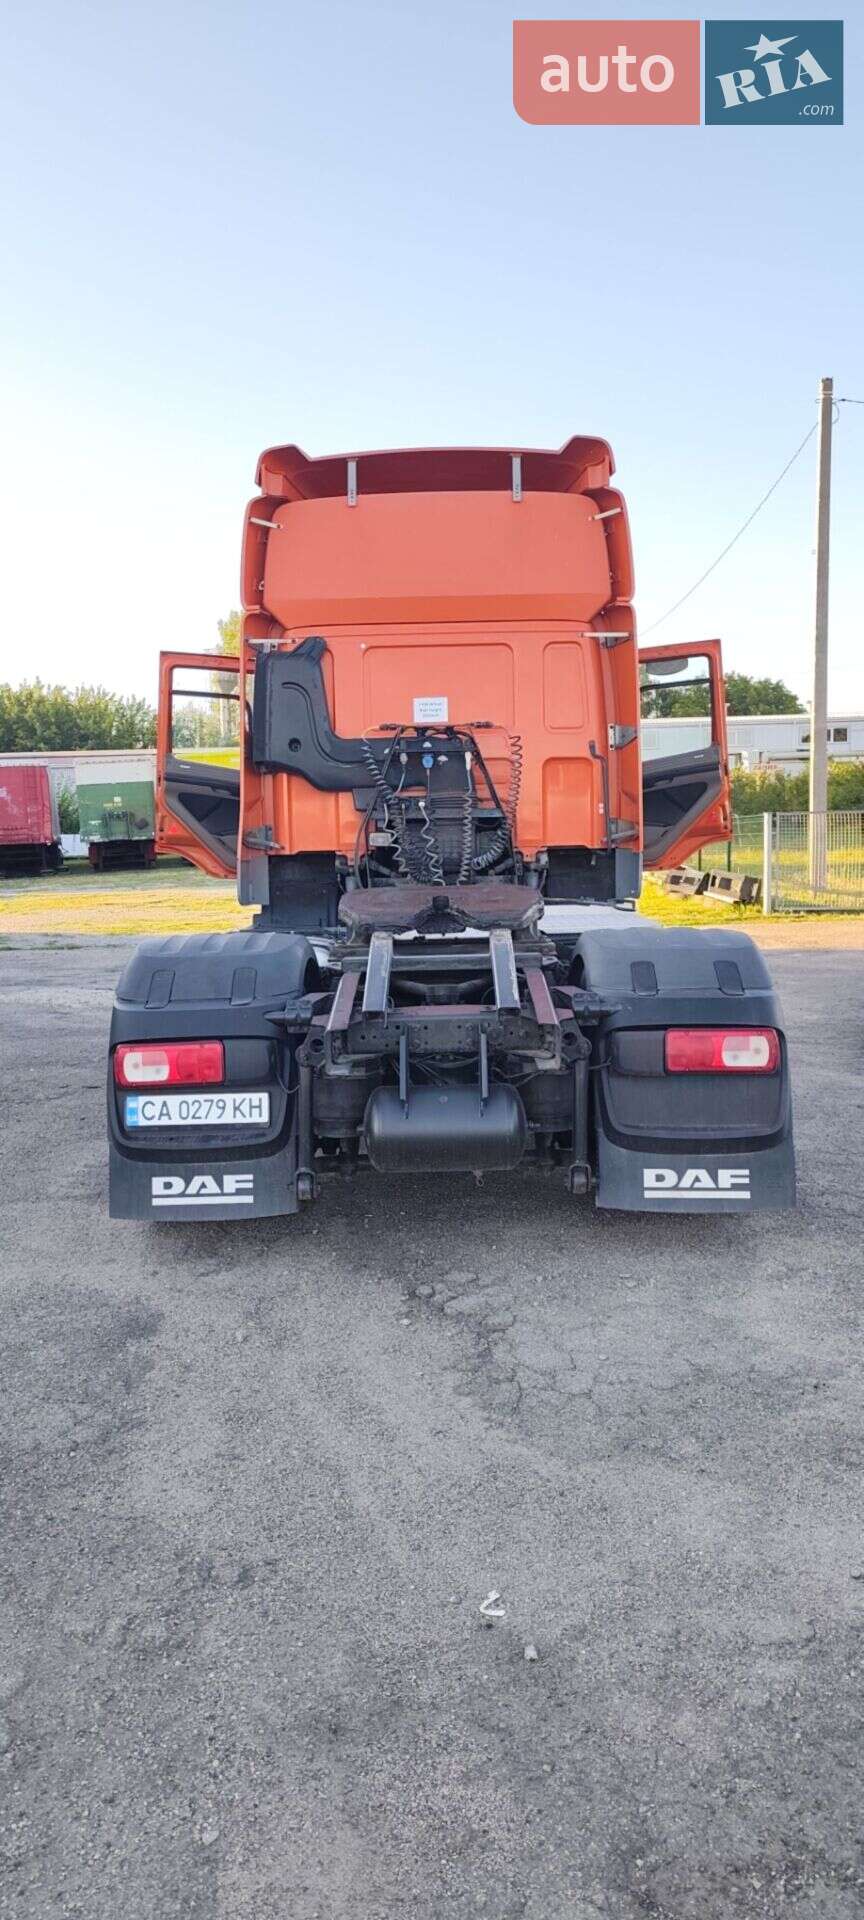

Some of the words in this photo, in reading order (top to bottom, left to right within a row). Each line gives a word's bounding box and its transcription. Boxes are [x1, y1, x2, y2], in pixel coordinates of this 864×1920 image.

[141, 1101, 172, 1121] CA
[179, 1099, 227, 1121] 0279
[232, 1097, 263, 1119] KH
[151, 1174, 254, 1196] DAF
[643, 1168, 750, 1189] DAF
